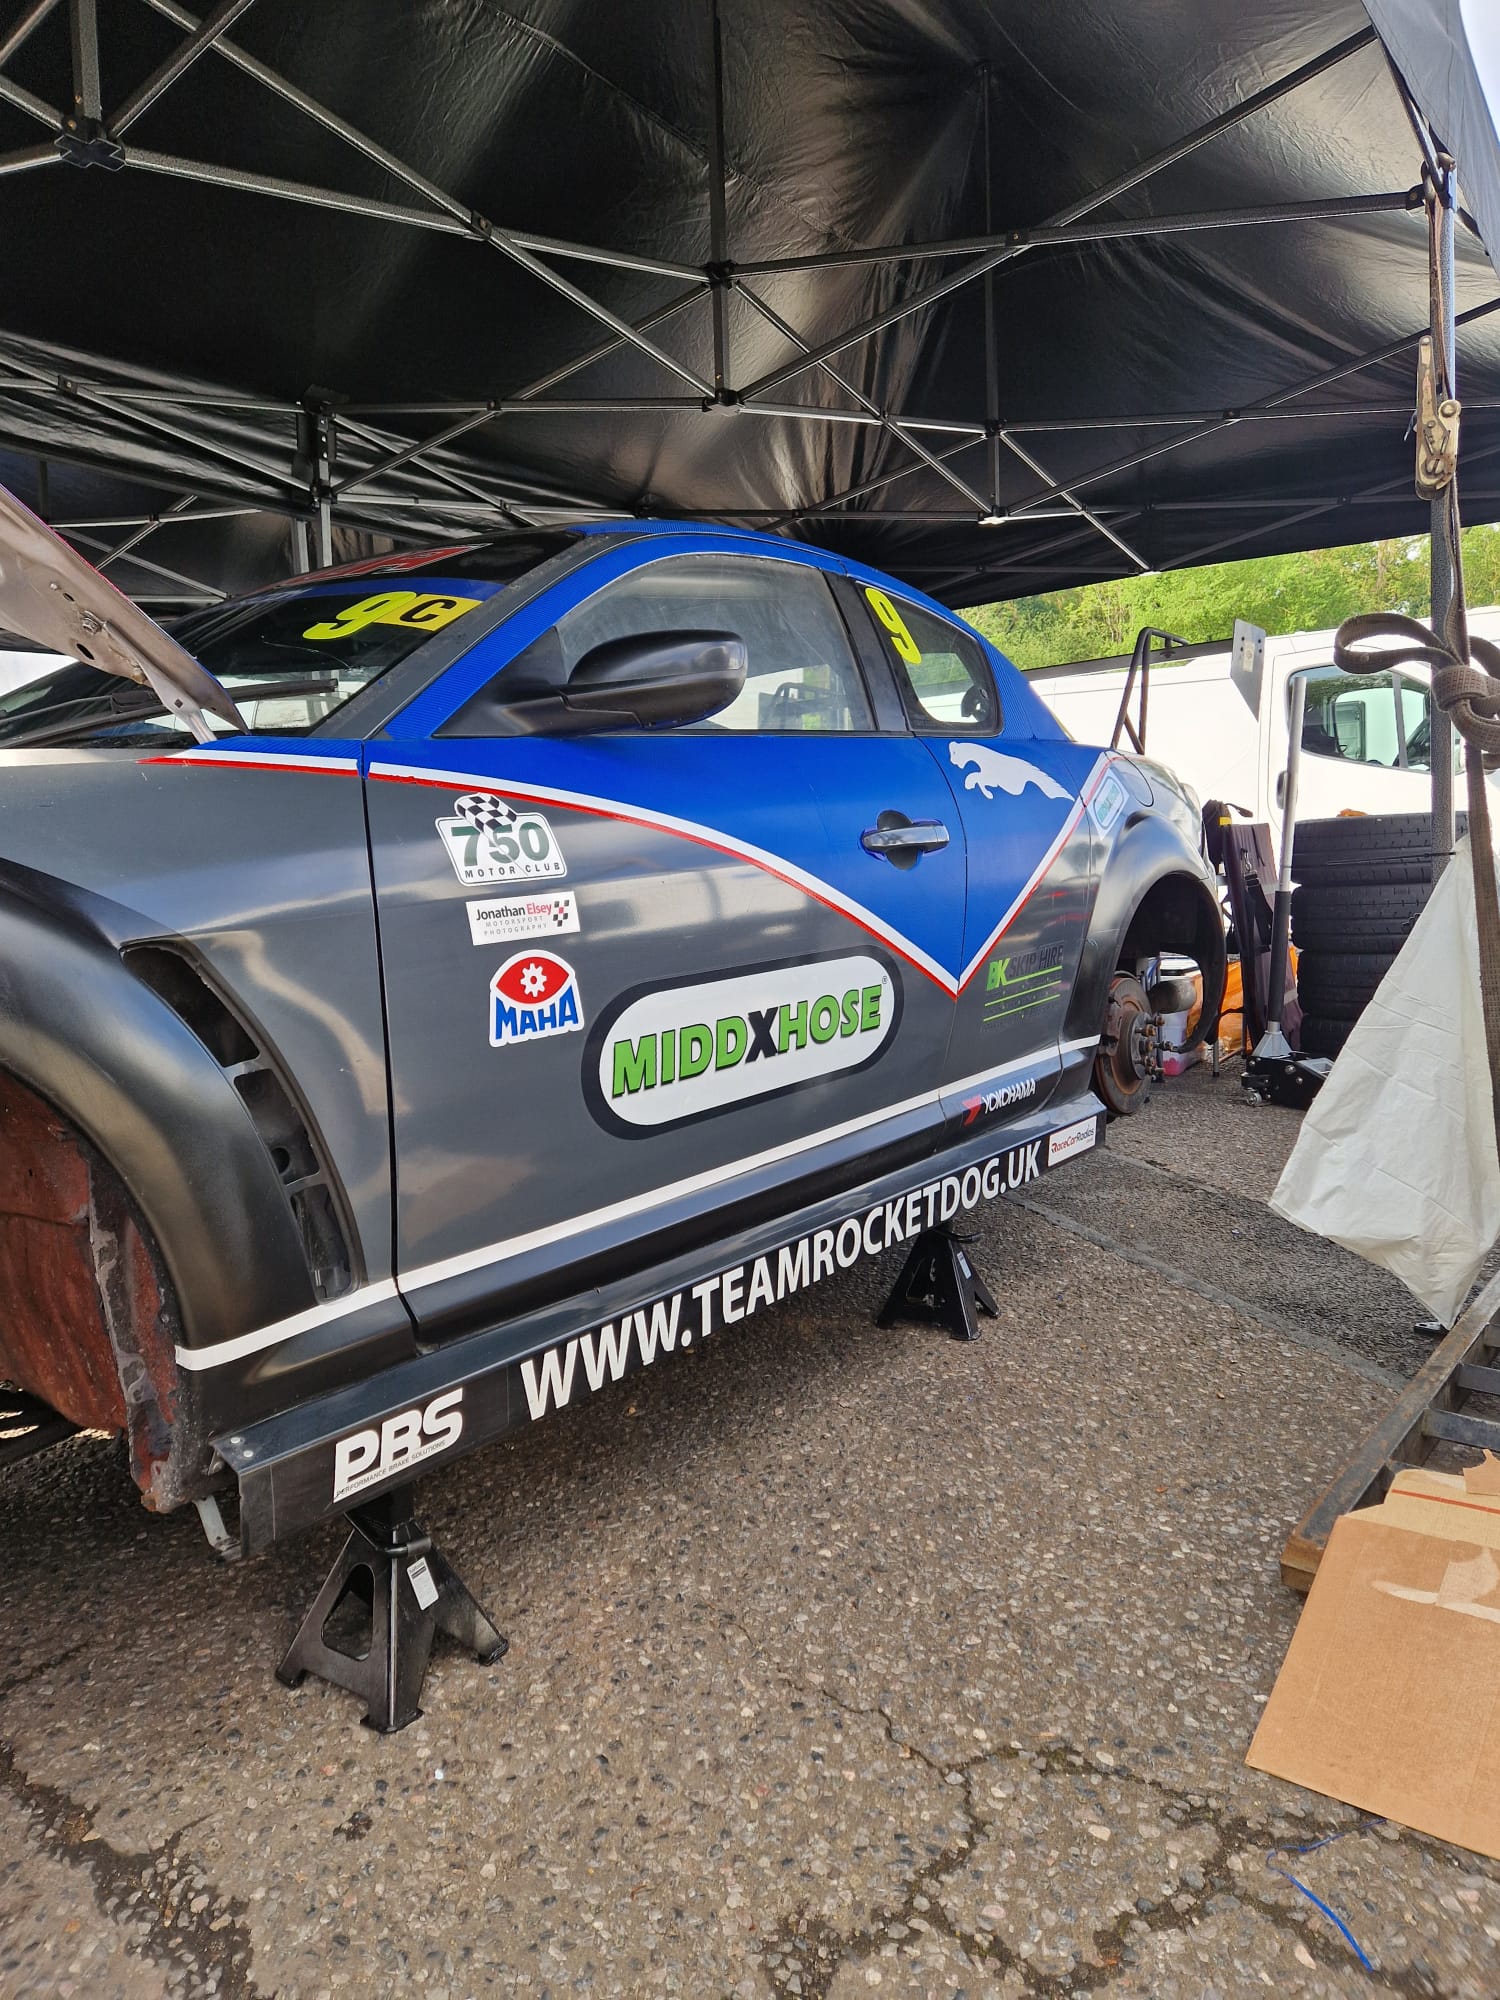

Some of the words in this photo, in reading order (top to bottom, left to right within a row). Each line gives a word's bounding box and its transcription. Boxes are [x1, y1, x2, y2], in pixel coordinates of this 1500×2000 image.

[302, 591, 416, 639] 9
[400, 599, 457, 623] C
[865, 587, 922, 665] 9
[451, 822, 550, 867] 750
[464, 865, 516, 879] MOTOR
[525, 862, 560, 874] CLUB
[476, 904, 526, 921] Jonathan
[526, 901, 552, 916] Elsey
[484, 923, 547, 936] PHOTOGRAPHY
[485, 915, 543, 928] MOTORSPORT
[986, 957, 1011, 991] BK
[1008, 951, 1037, 979] SKIP
[1038, 943, 1064, 970] HIRE
[496, 985, 579, 1040] MAHA
[611, 984, 883, 1099] MIDDXHOSE
[982, 1078, 1036, 1114] YOKOHAMA
[520, 1141, 1042, 1421] WWW.TEAMROCKETDOG.UK
[333, 1387, 464, 1504] PBS
[336, 1467, 387, 1498] PERFORMANCE
[388, 1457, 411, 1473] BRAKE
[411, 1440, 446, 1460] SOLUTIONS
